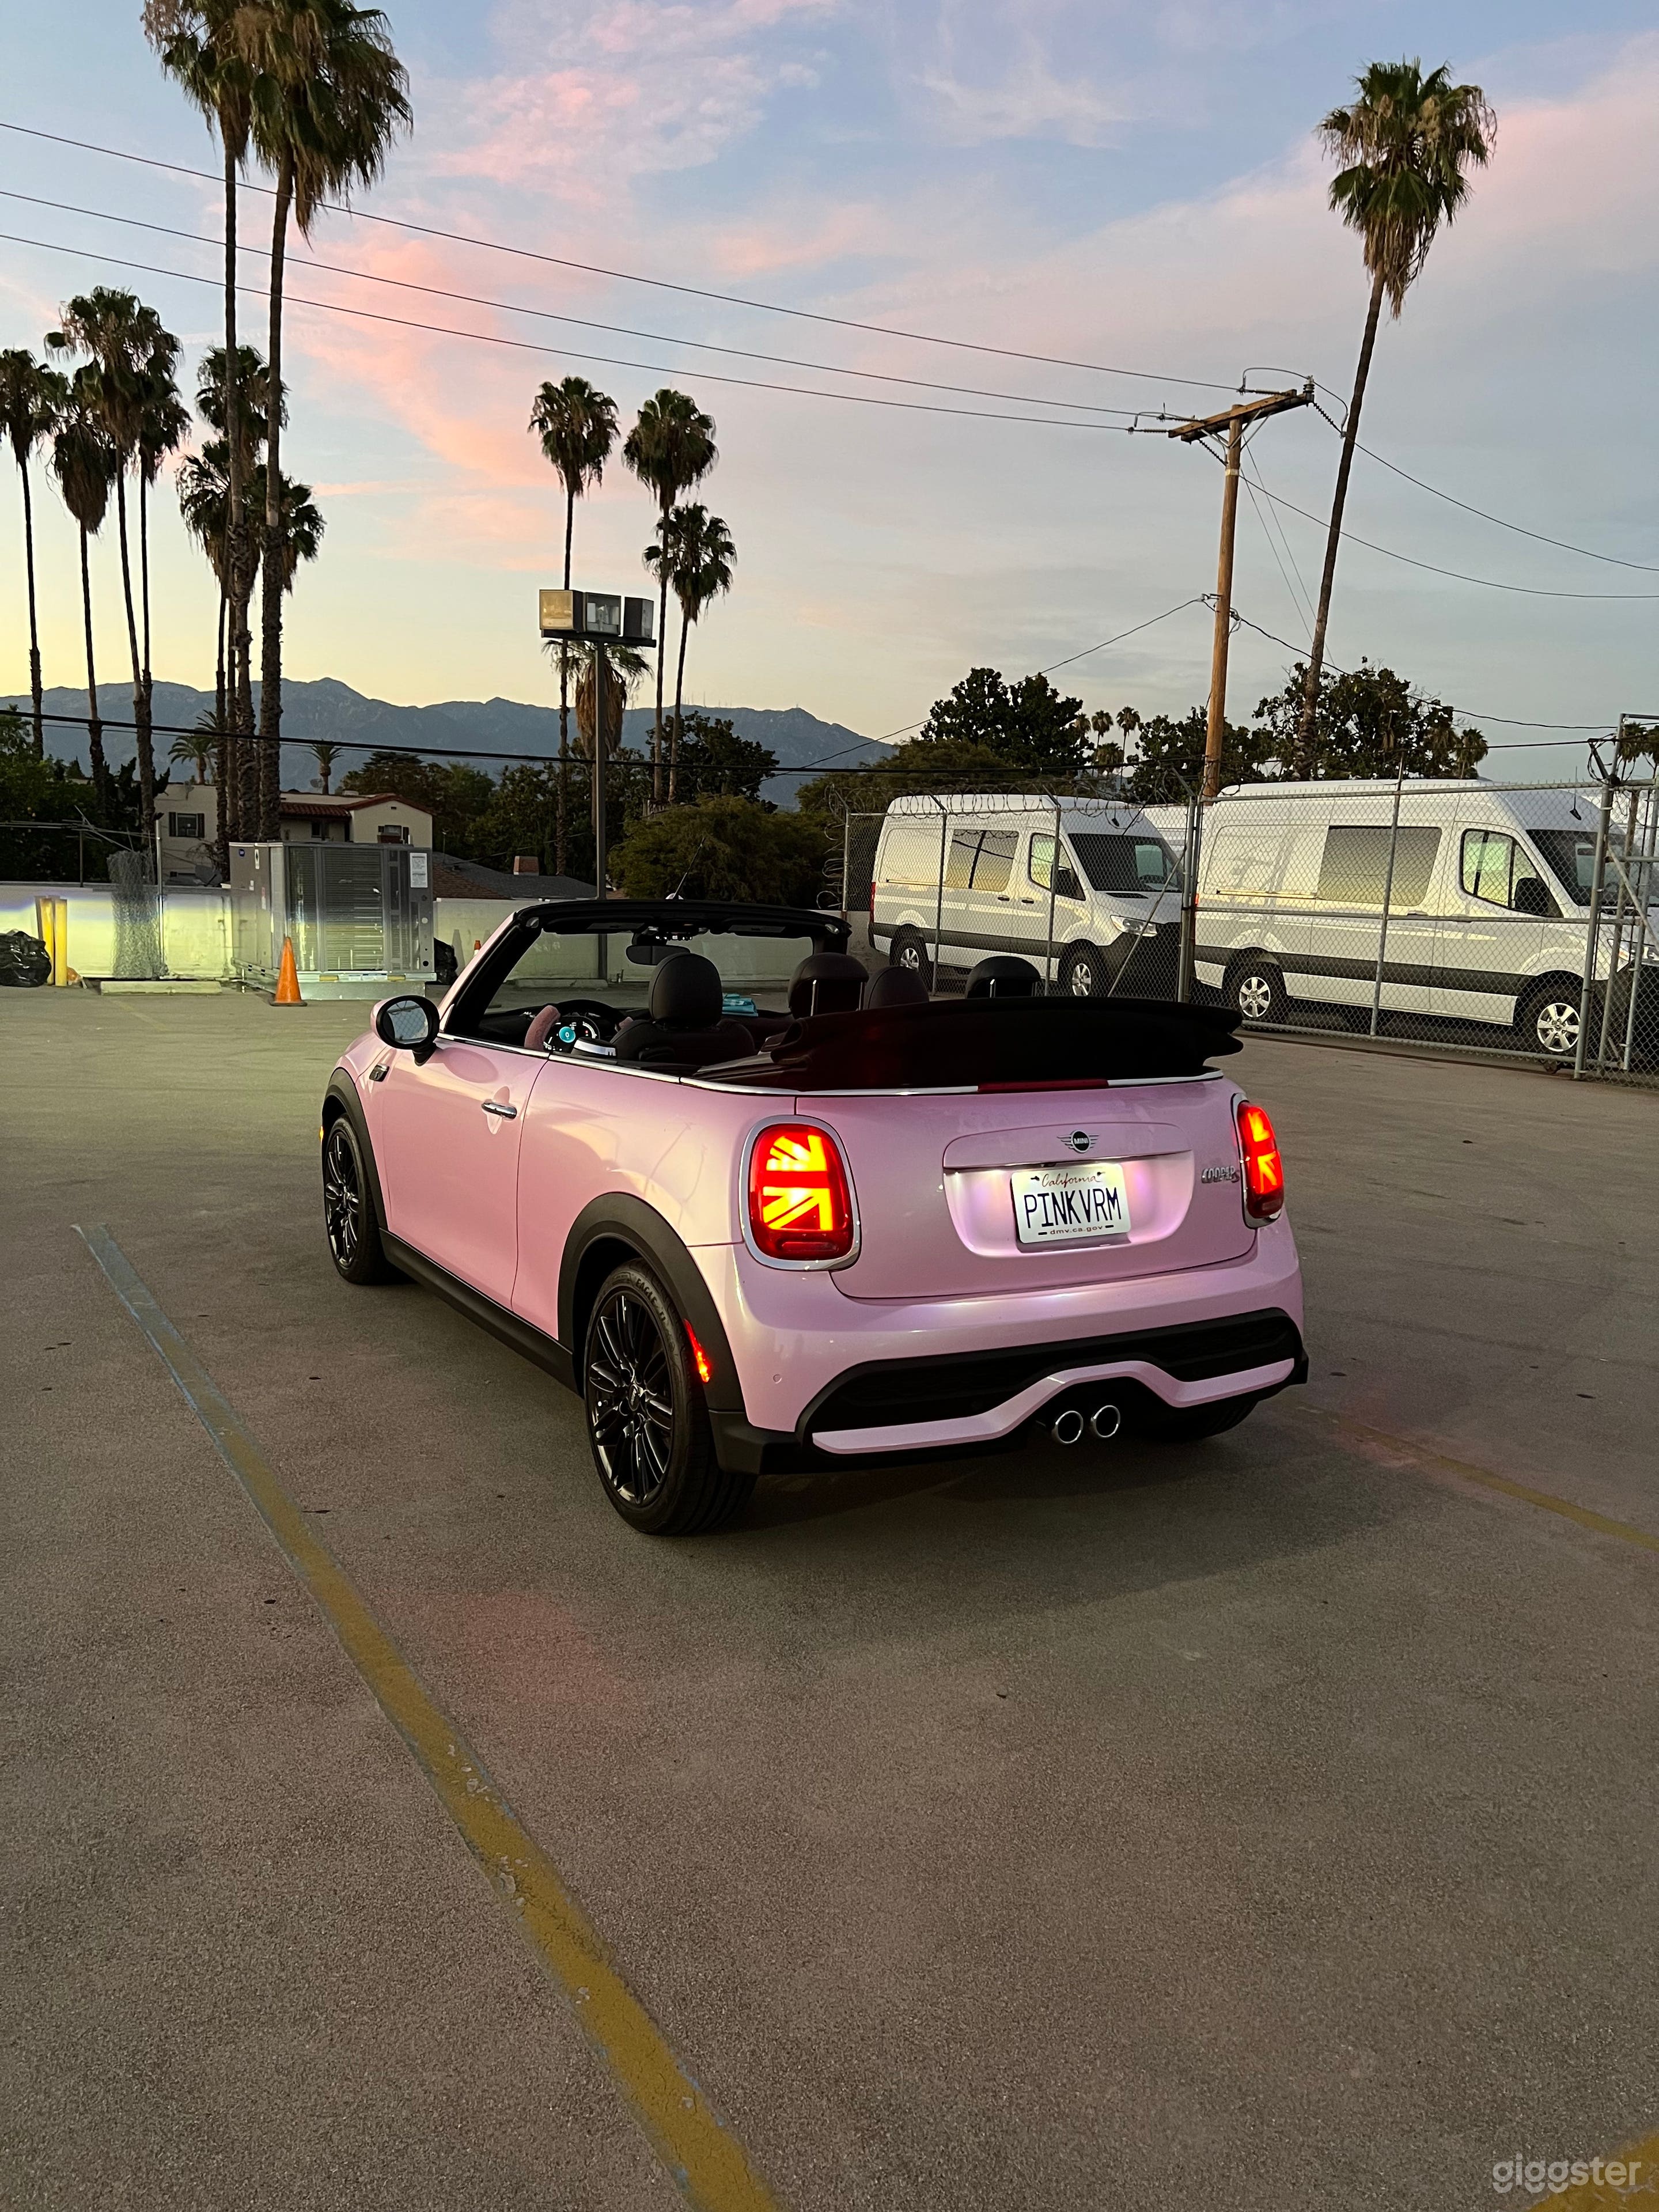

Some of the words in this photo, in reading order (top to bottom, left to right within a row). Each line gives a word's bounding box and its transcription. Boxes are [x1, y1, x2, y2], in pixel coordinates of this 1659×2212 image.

[1041, 1172, 1101, 1188] California
[1024, 1187, 1122, 1229] PINKVRM
[1050, 1225, 1103, 1235] dmv.ca.gov
